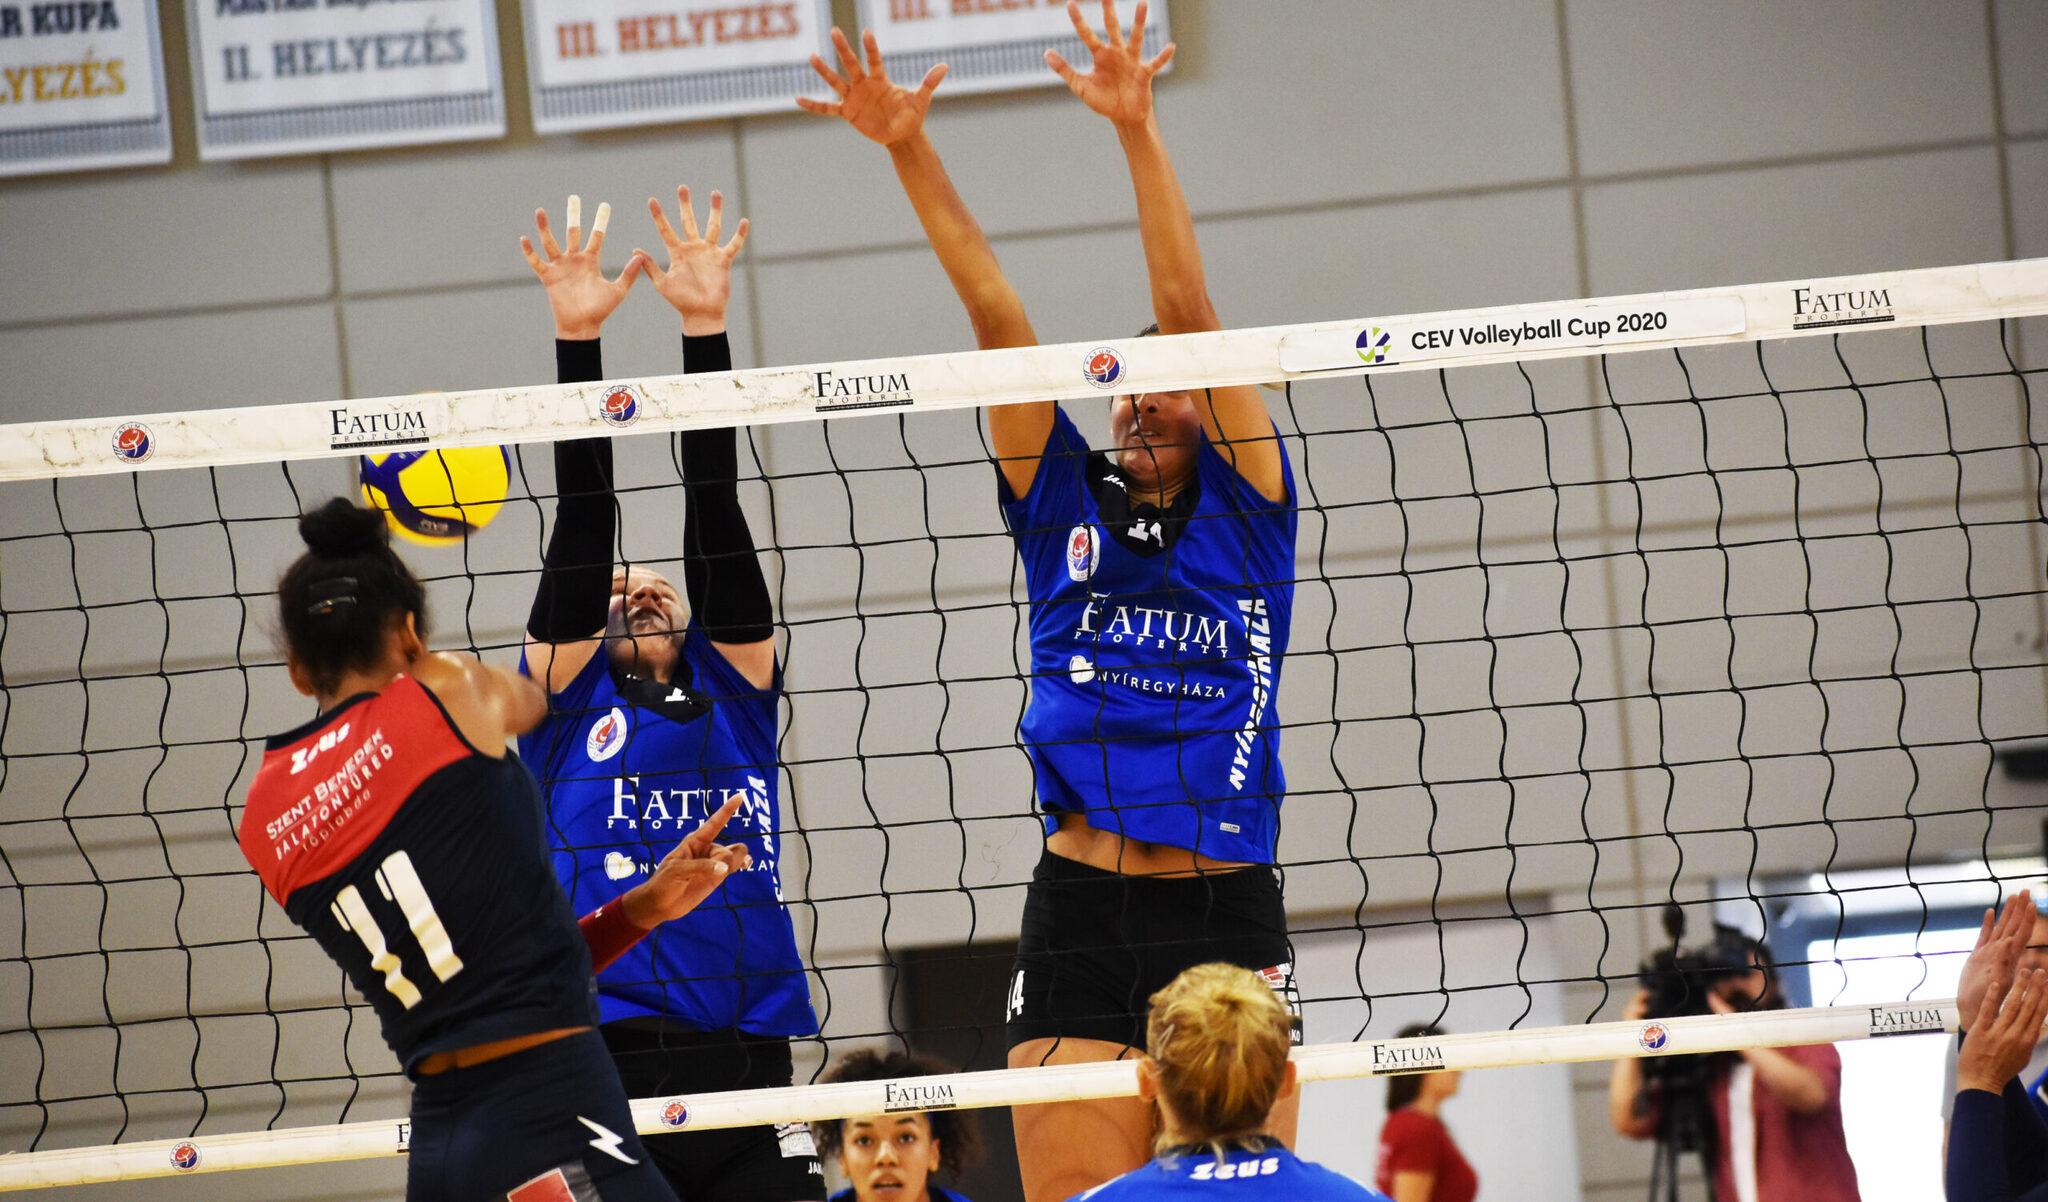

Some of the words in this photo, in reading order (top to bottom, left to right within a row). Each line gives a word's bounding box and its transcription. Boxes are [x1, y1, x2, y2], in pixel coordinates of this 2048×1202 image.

[31, 1, 121, 36] KUPA
[271, 16, 467, 79] HELYEZÉS
[0, 46, 127, 105] YEZÉS
[1791, 284, 1893, 316] FATUM
[1794, 308, 1893, 323] PROPERTY
[1410, 328, 1455, 351] CEV
[1459, 318, 1562, 347] Volleyball
[1567, 317, 1612, 339] Cup
[1616, 311, 1668, 334] 2020
[814, 368, 911, 398] FATUM
[816, 392, 912, 406] PROPERTY
[329, 406, 427, 436] FATUM
[331, 430, 428, 444] PROPERTY
[1076, 592, 1228, 649] FATUM
[330, 849, 465, 1011] 11
[1868, 1005, 1943, 1027] FATUM
[1371, 1044, 1443, 1065] FATUM
[884, 1082, 955, 1103] FATUM
